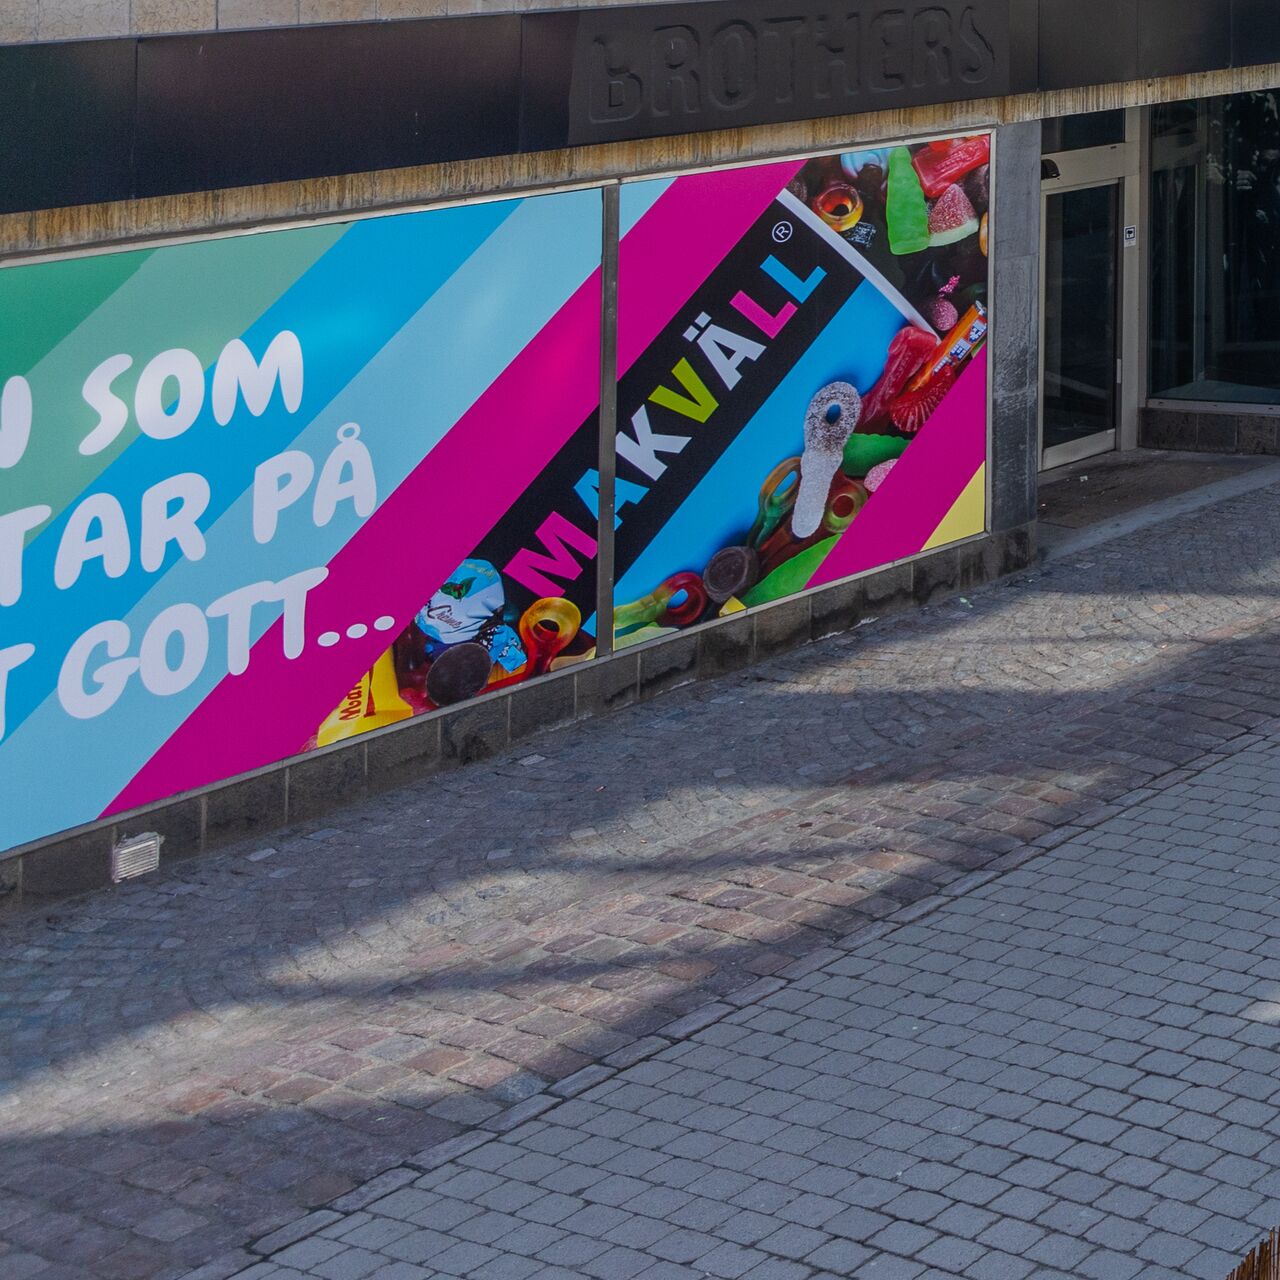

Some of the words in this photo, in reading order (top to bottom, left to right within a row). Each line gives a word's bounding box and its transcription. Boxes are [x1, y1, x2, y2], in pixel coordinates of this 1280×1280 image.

[588, 5, 997, 123] BROTHERS
[80, 328, 304, 456] SOM
[504, 254, 828, 598] MAKVÄLL
[252, 422, 378, 545] PÅ
[57, 566, 396, 720] GOTT...
